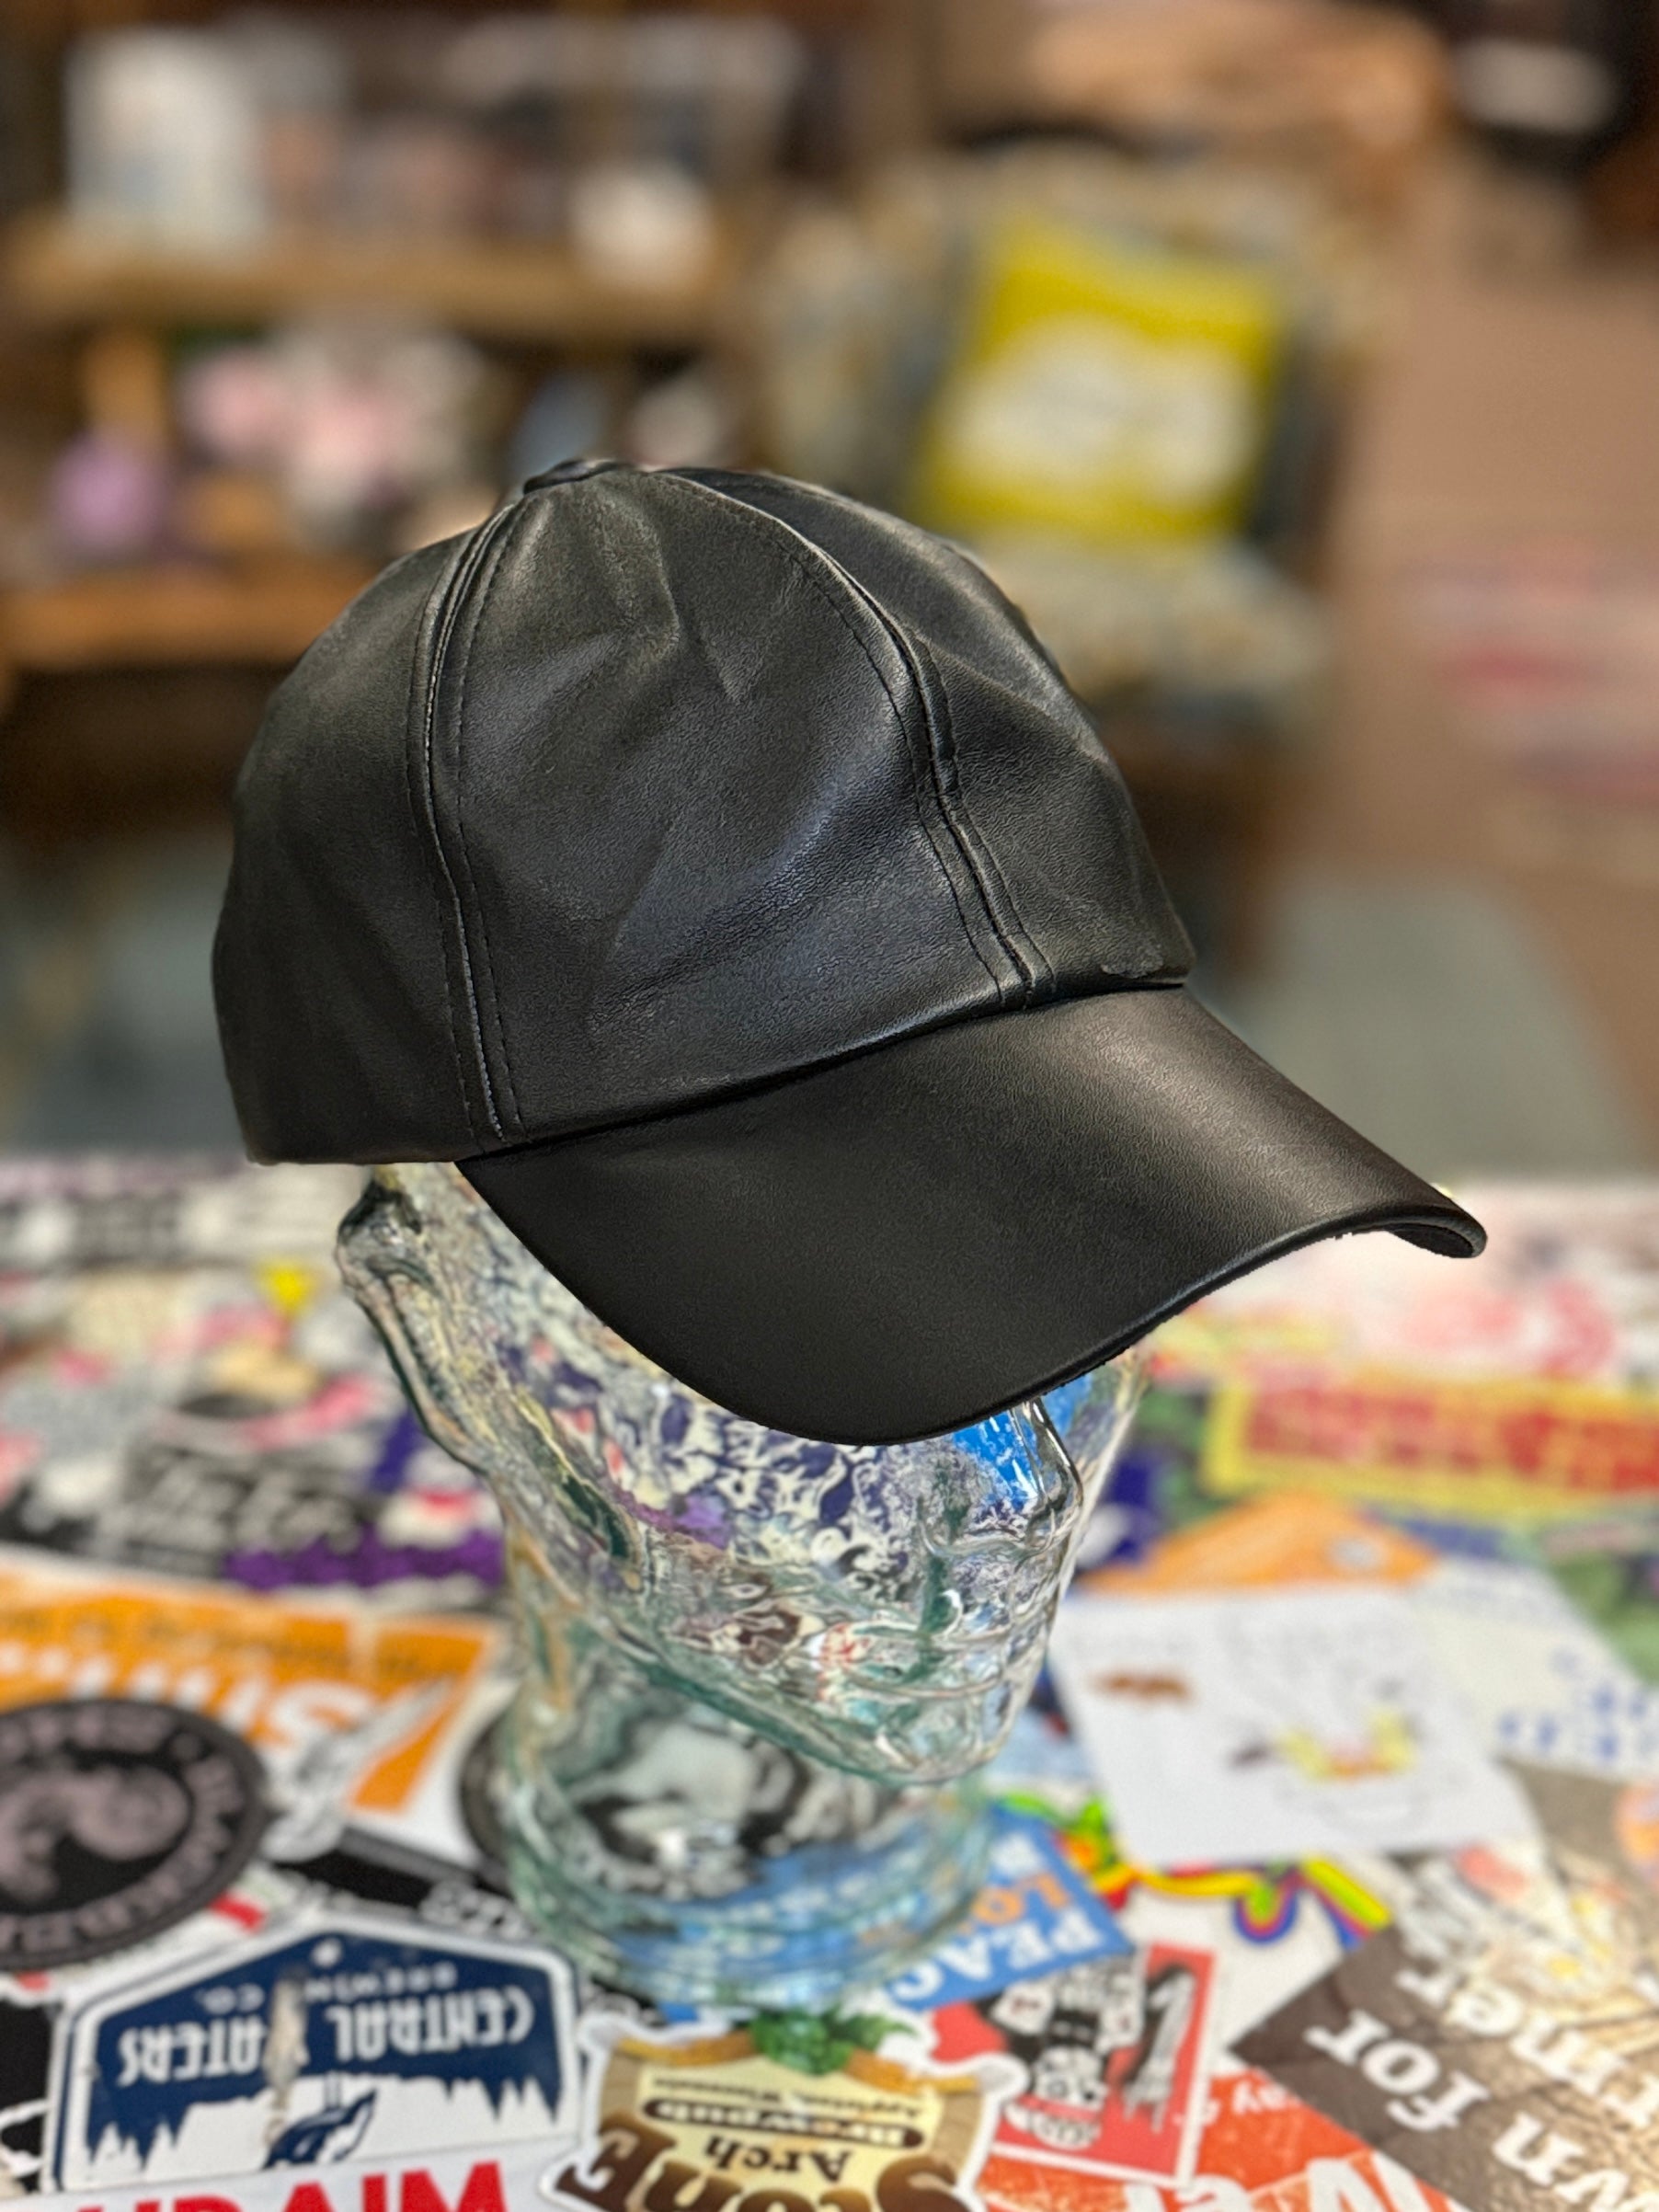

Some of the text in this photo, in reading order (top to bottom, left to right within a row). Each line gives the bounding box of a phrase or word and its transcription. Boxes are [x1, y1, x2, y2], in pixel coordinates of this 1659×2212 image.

[303, 1962, 457, 2006] BREWIN
[115, 2015, 266, 2087] ATERS
[326, 1985, 534, 2063] CENTRAL
[1304, 2009, 1488, 2133] for
[702, 2136, 852, 2183] Arch
